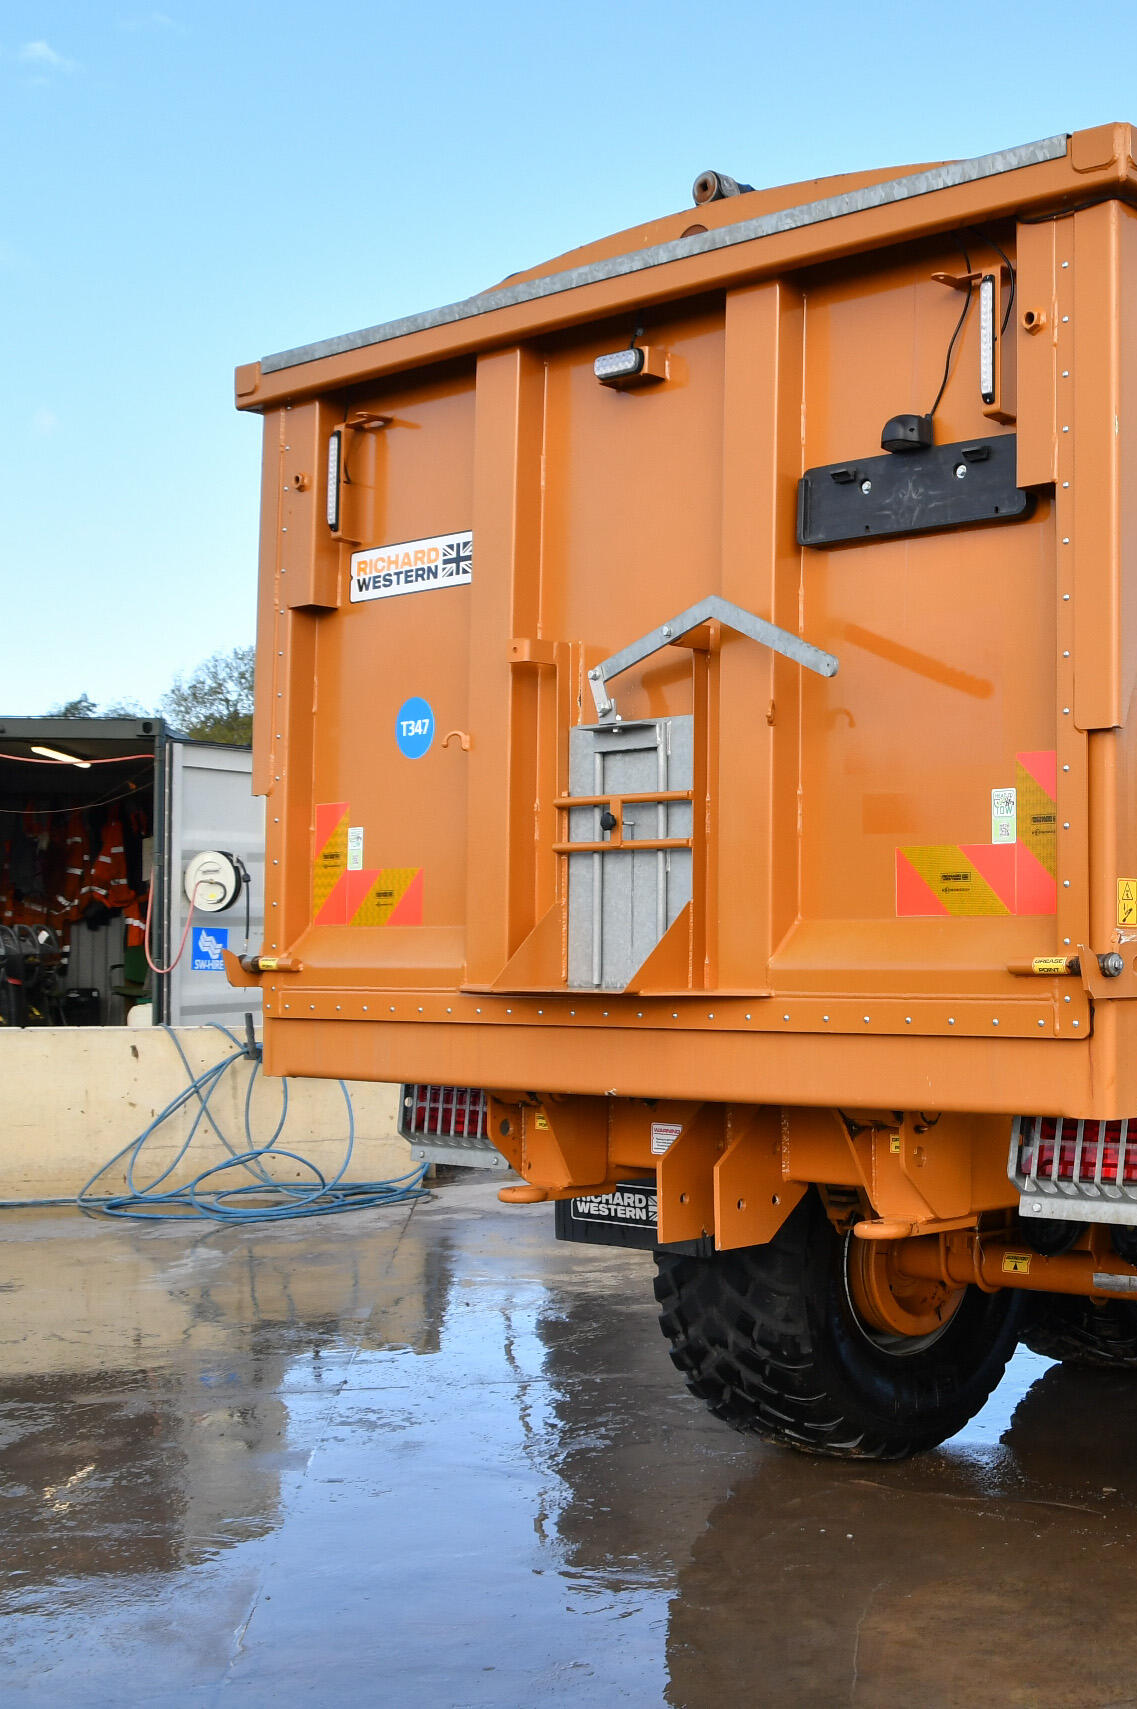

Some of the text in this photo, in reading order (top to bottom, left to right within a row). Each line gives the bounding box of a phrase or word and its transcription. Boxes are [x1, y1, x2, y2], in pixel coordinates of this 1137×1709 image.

[356, 547, 440, 577] RICHARD
[357, 565, 438, 592] WESTERN
[400, 718, 430, 737] T347
[576, 1201, 647, 1221] WESTERN
